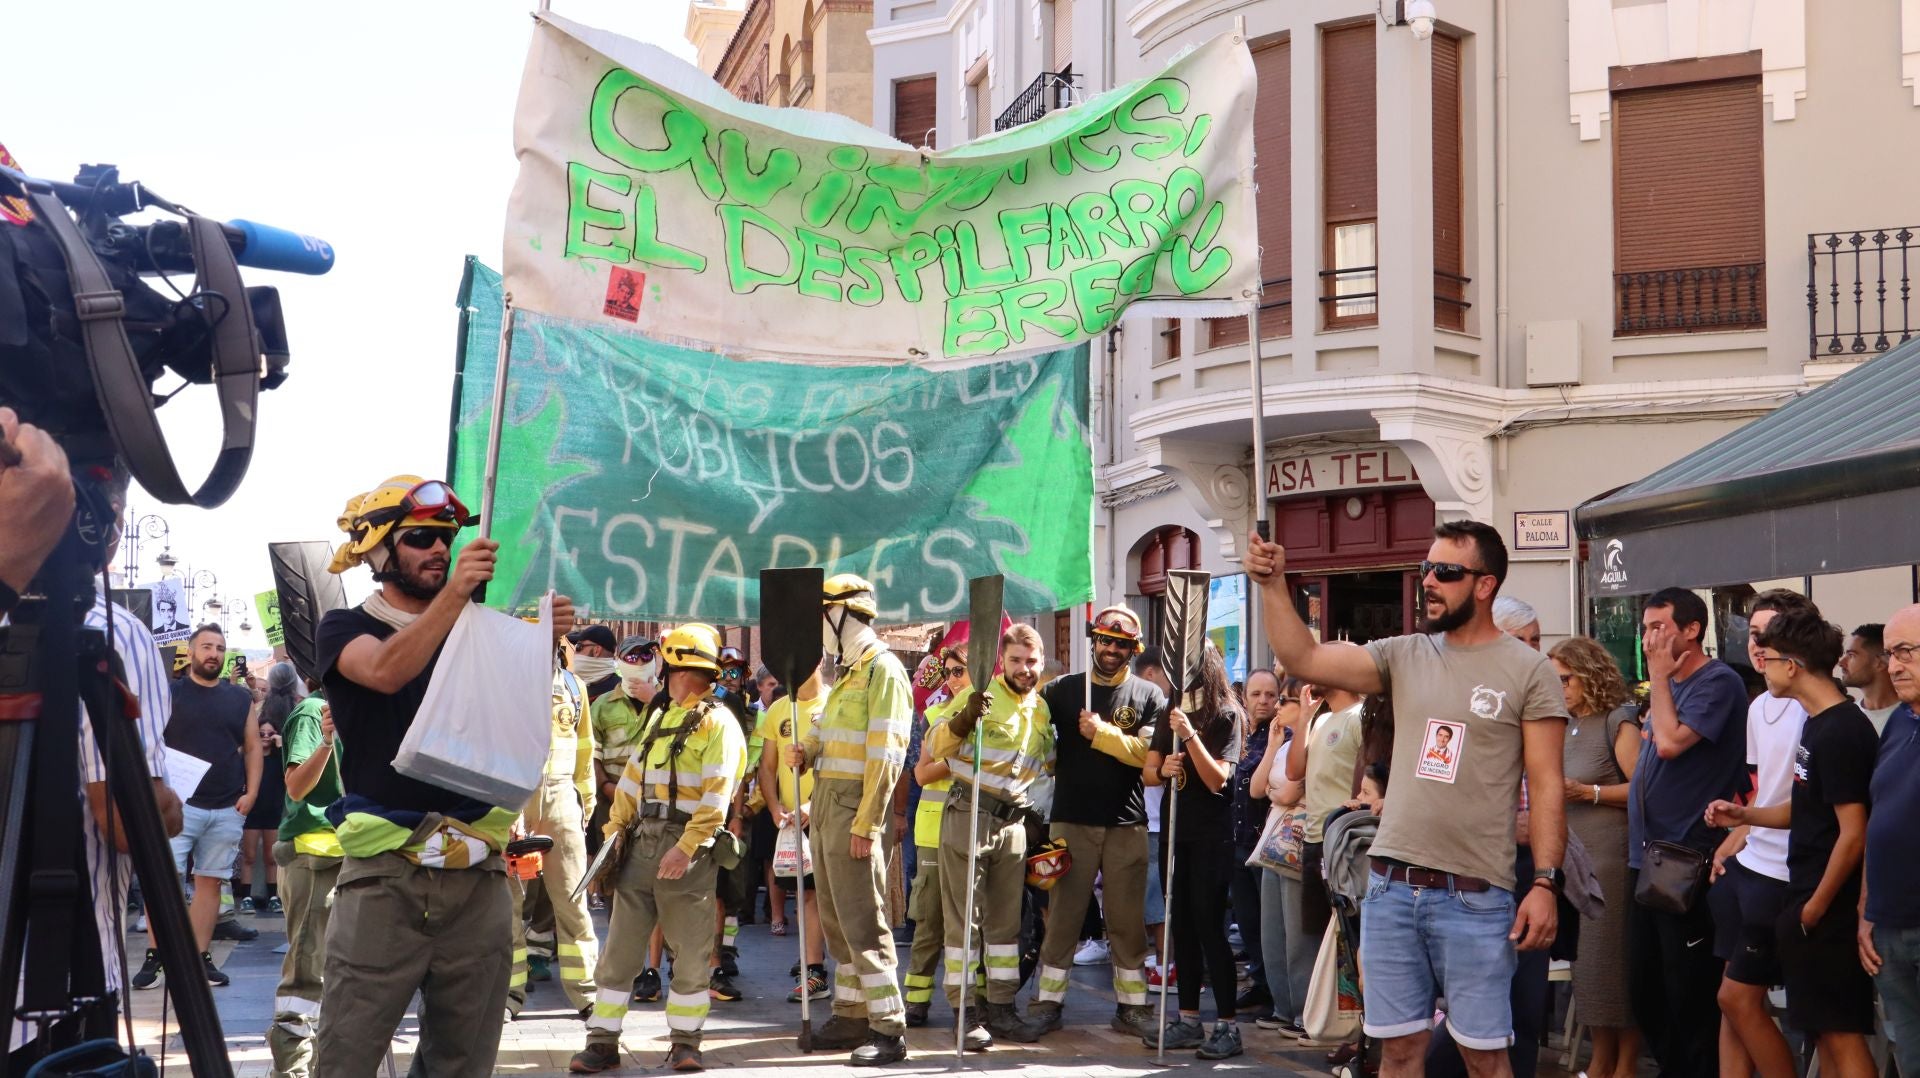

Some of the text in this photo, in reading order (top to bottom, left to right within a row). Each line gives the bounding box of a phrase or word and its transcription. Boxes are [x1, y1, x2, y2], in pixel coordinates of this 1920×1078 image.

[564, 161, 707, 274] EL
[1268, 458, 1315, 494] ASA
[1531, 518, 1553, 527] CALLE
[1525, 531, 1560, 542] PALOMA
[1423, 760, 1449, 770] PELIGRO
